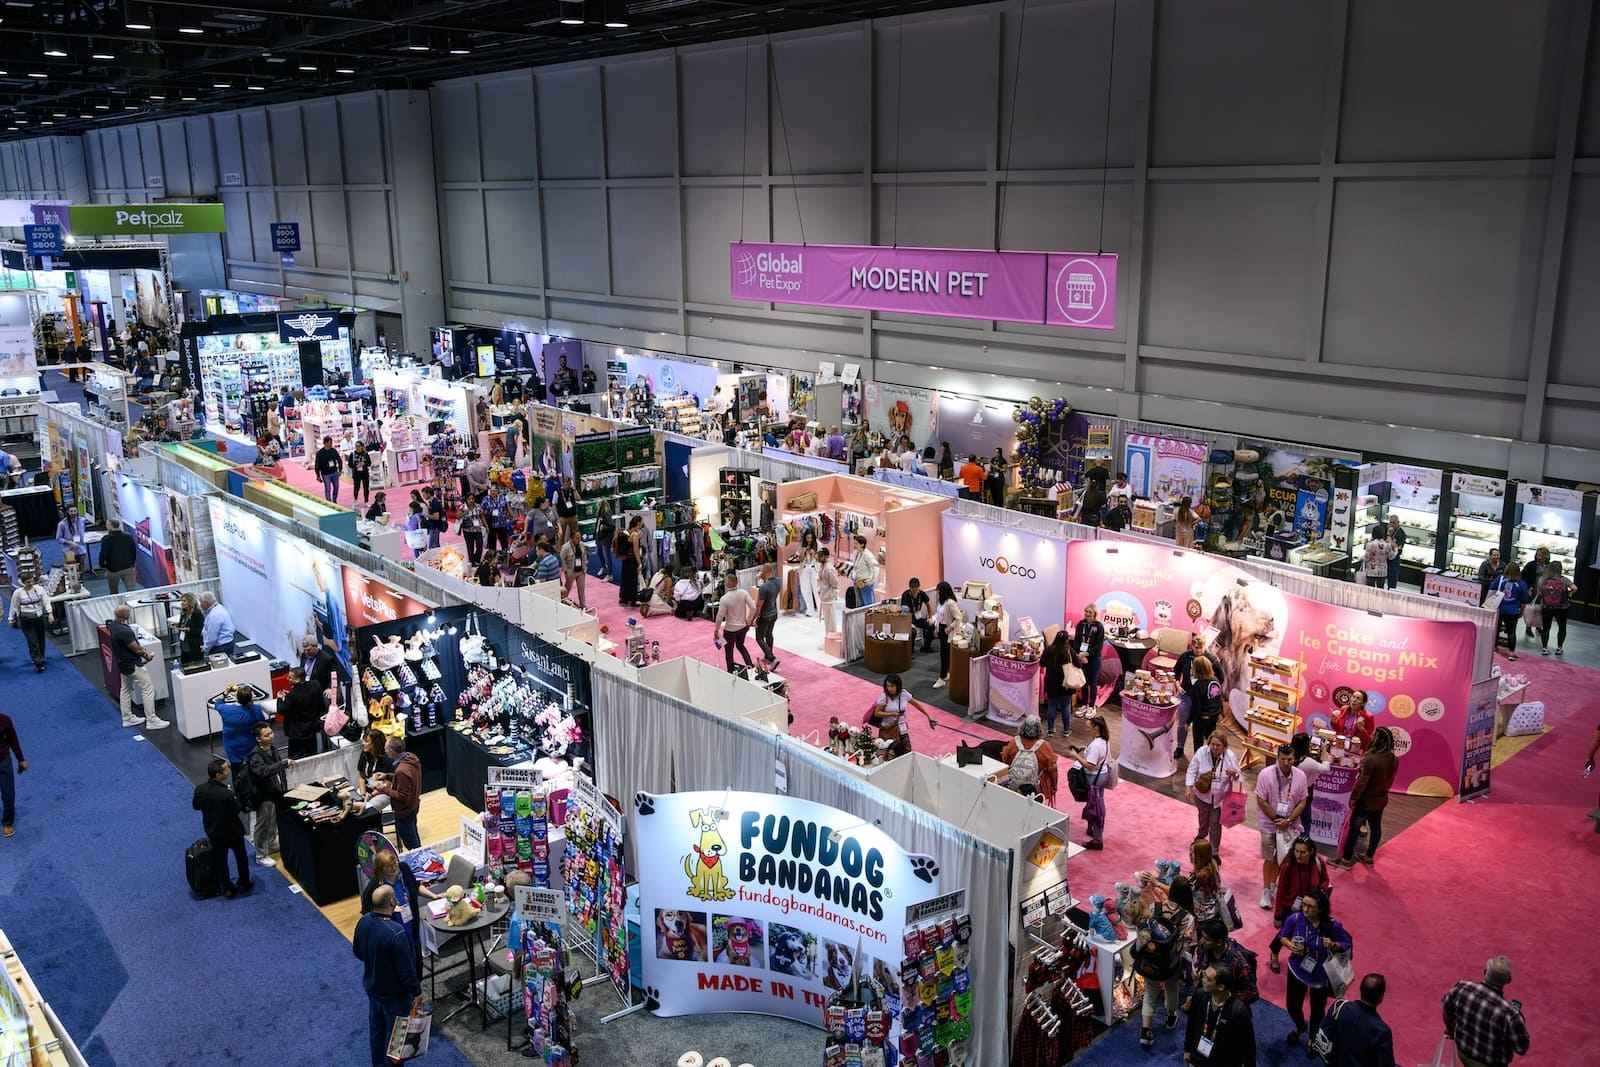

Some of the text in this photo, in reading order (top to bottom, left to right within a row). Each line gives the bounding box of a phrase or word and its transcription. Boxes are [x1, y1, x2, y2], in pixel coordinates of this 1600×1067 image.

[116, 209, 184, 228] Petpalz
[756, 253, 803, 274] Global
[850, 266, 989, 297] MODERN PET
[361, 590, 398, 620] VetsPlus
[1103, 614, 1135, 626] puppy
[1300, 630, 1438, 669] Ice Cream Mix
[1325, 623, 1409, 650] Cake and
[1010, 662, 1027, 670] MIX
[1319, 655, 1405, 682] for Dogs!
[1317, 780, 1340, 791] DOGS!
[1331, 776, 1349, 785] CUP
[740, 811, 884, 889] FUNDOG
[738, 885, 887, 944] fundogbandanas.com
[697, 972, 827, 1009] MADE IN TH
